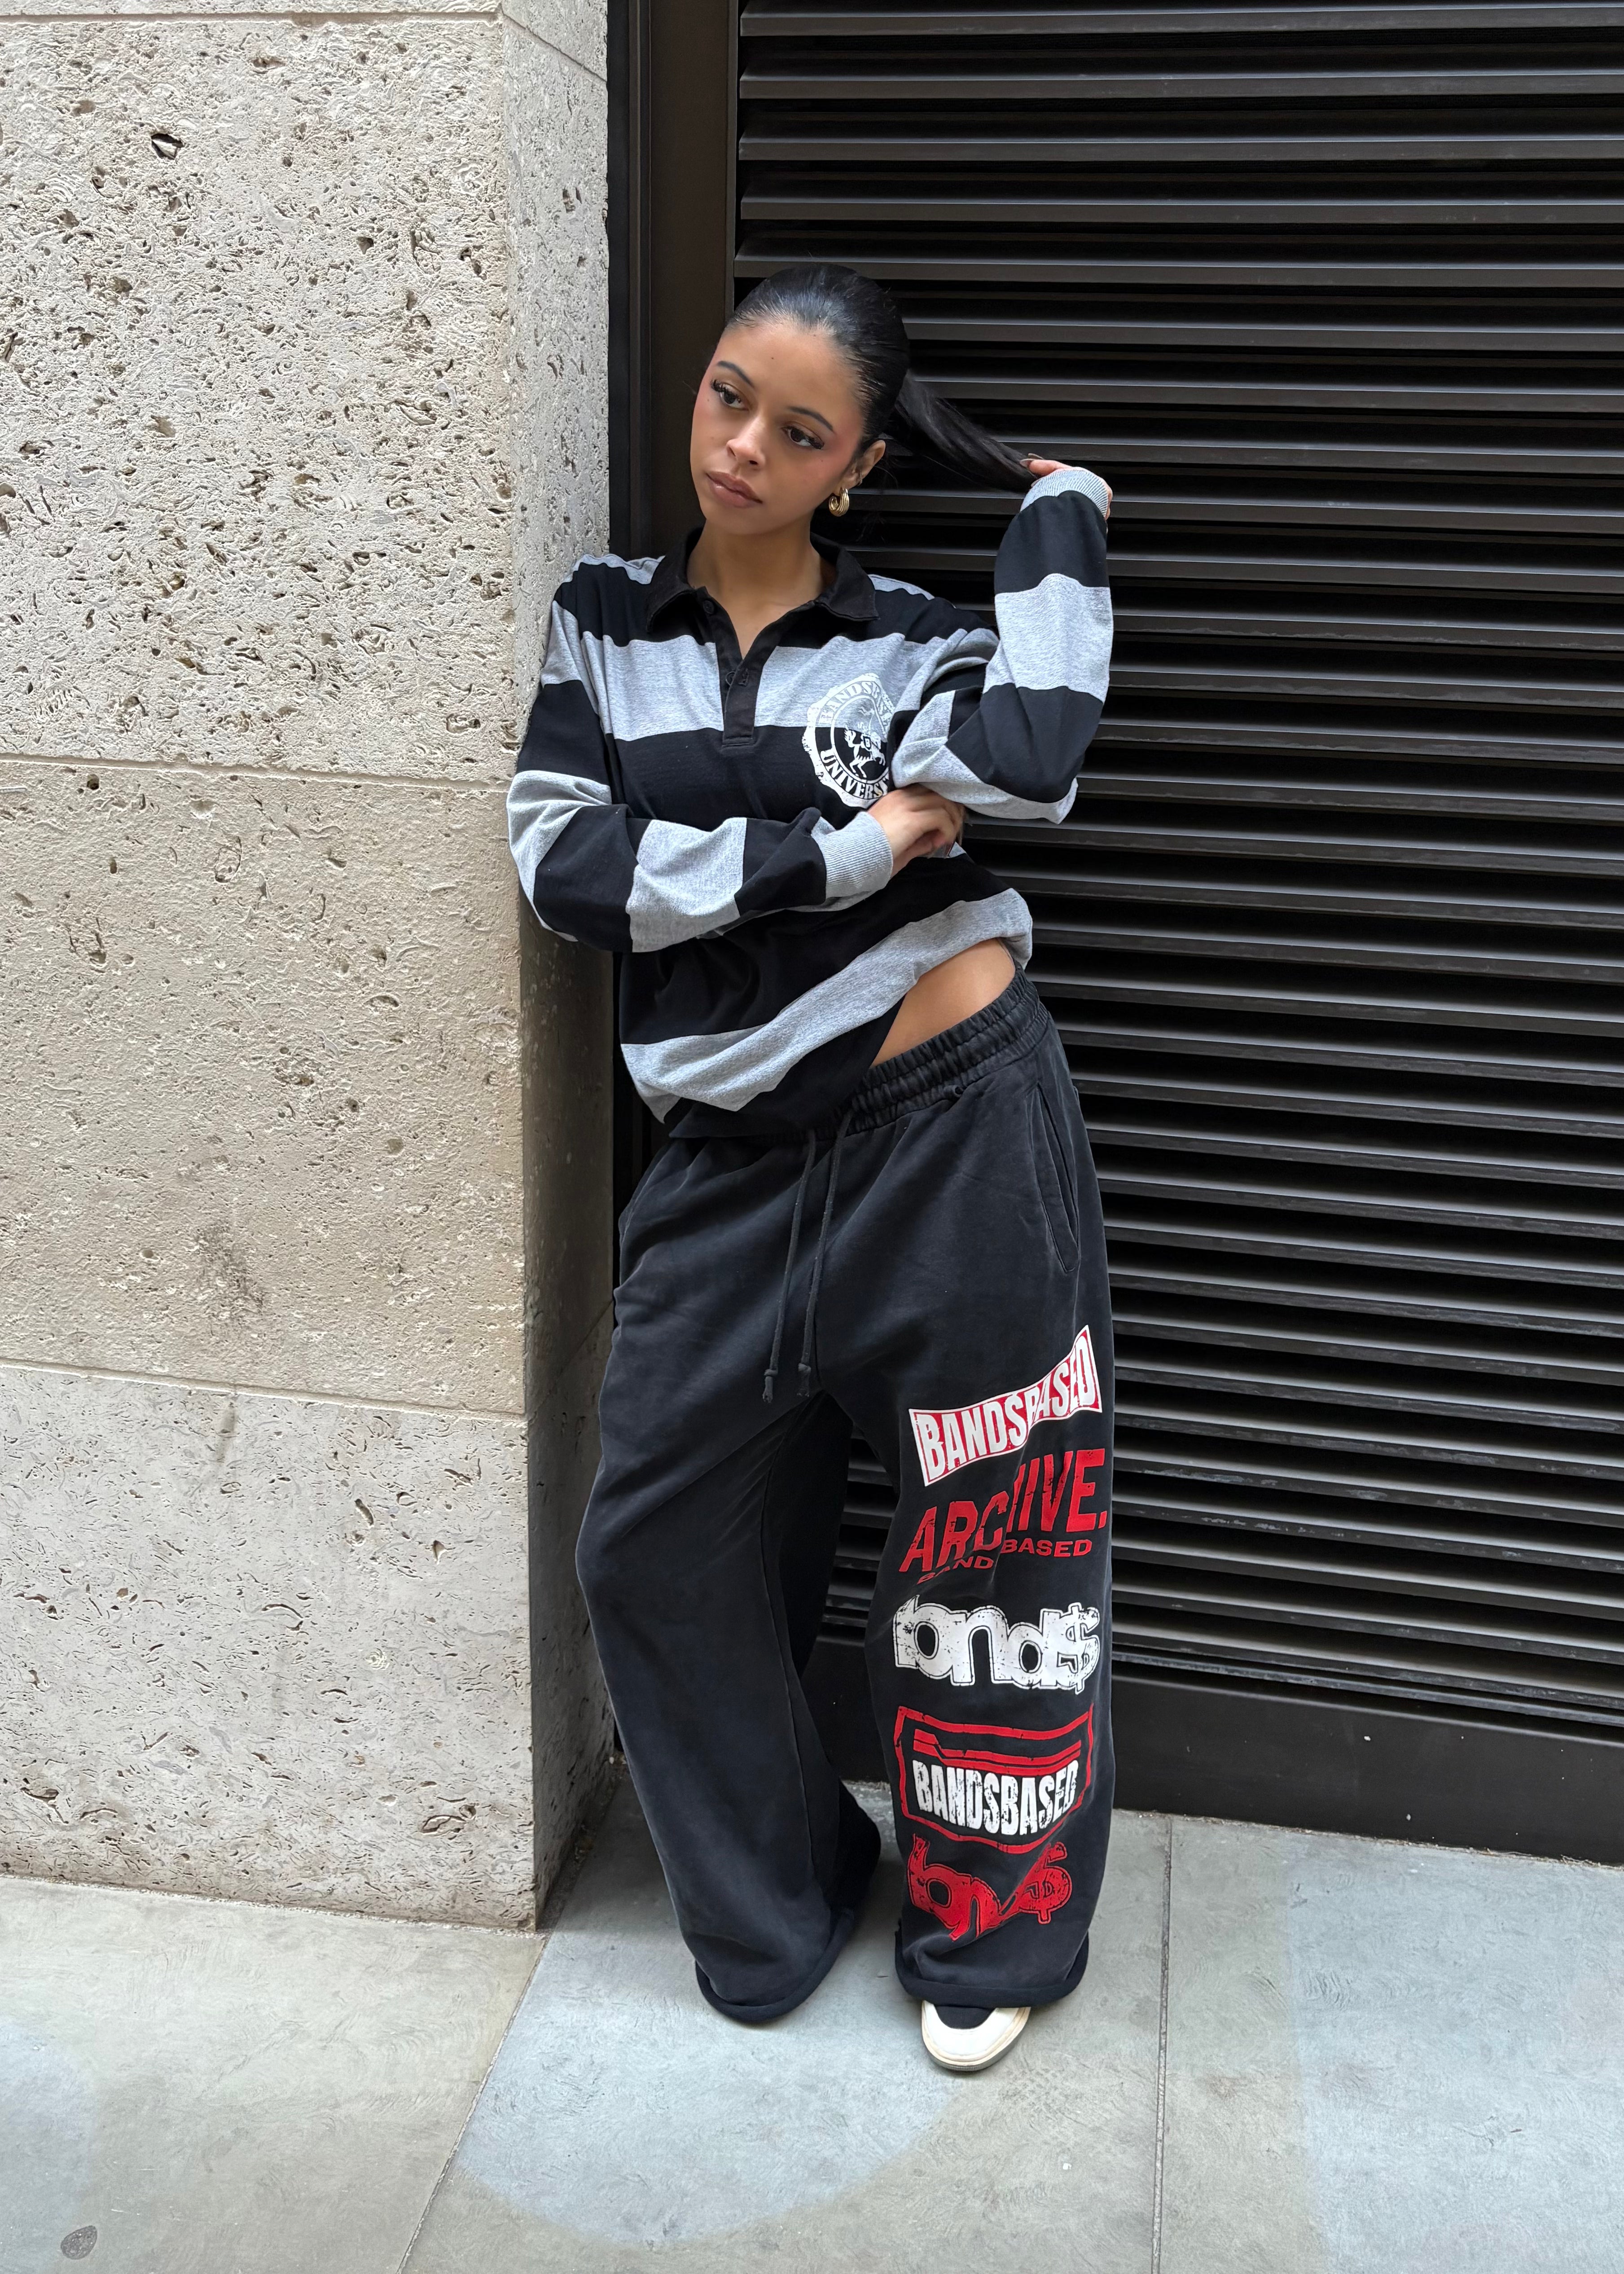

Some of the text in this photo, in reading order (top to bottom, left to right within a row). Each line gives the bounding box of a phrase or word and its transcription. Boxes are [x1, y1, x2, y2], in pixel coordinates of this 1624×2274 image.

[820, 749, 889, 799] UNIVERSI
[916, 1336, 1096, 1481] BANDSBASED
[912, 1759, 1079, 1835] BANDSBASED
